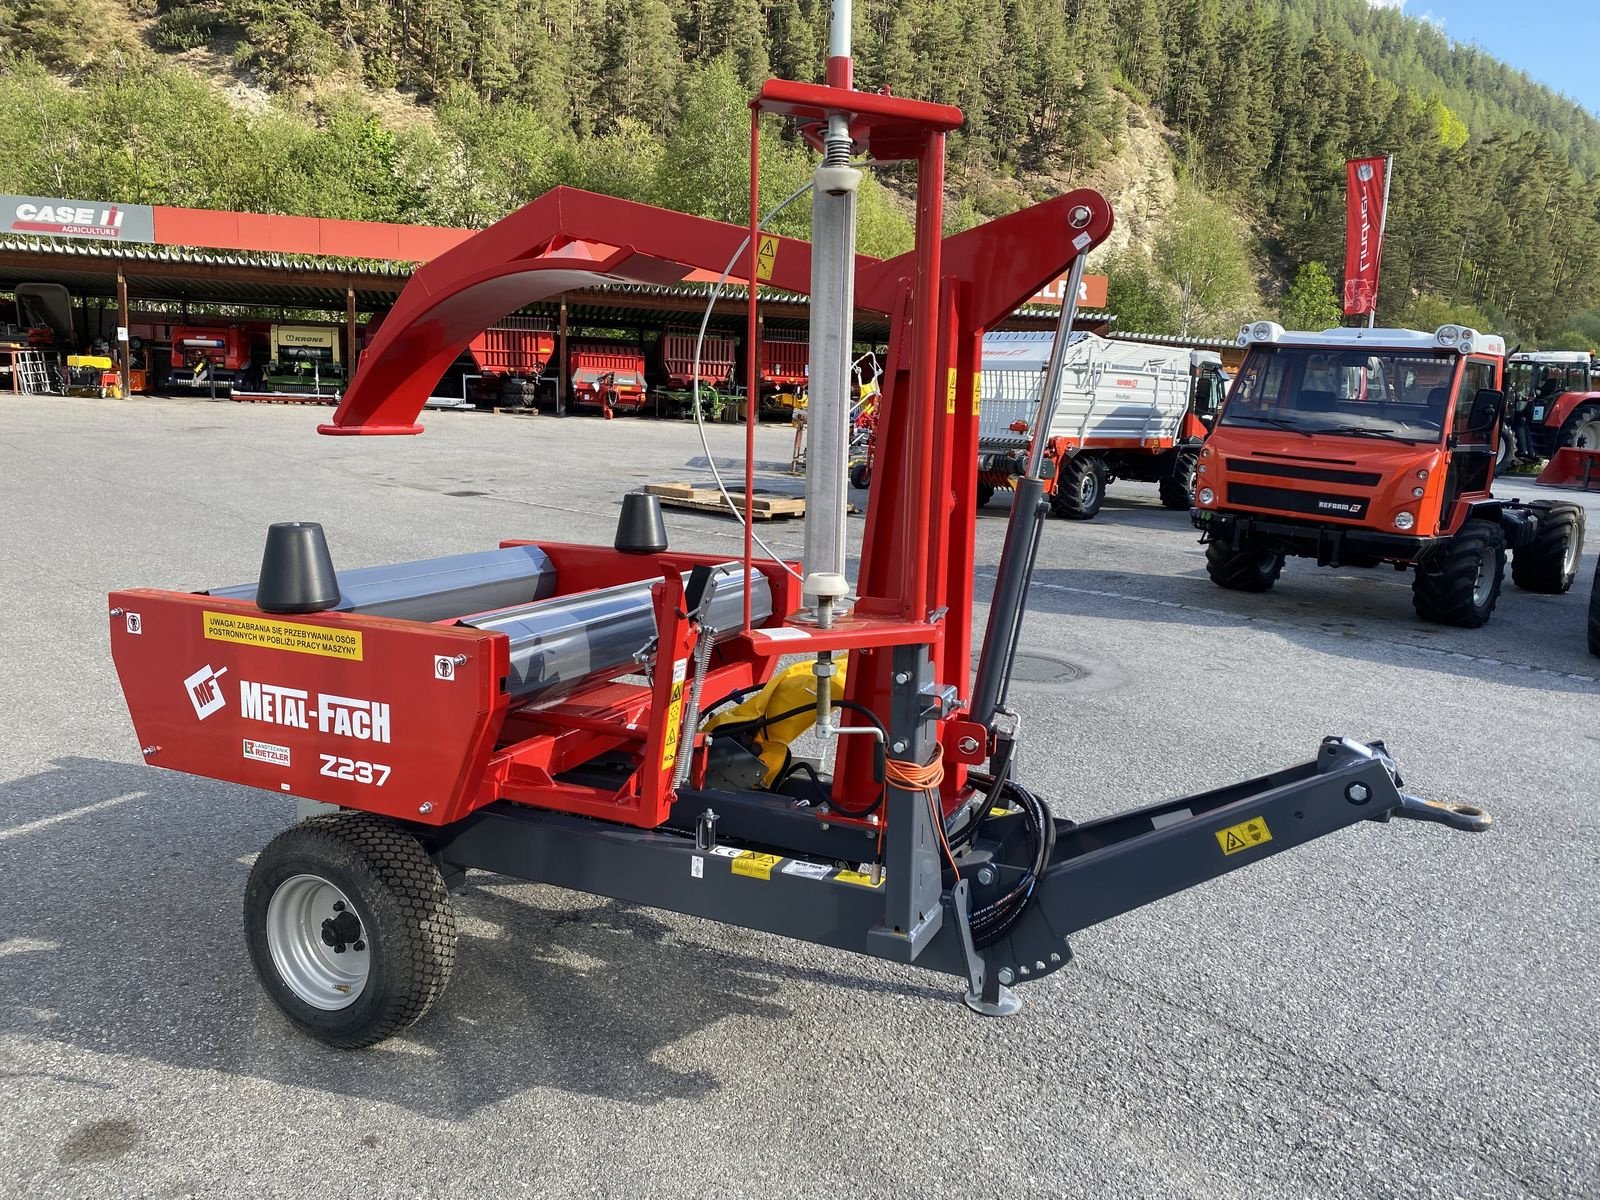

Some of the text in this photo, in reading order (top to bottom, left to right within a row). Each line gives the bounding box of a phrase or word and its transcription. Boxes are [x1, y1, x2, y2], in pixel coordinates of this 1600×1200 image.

[16, 203, 95, 225] CASE
[62, 226, 116, 236] AGRICULTURE
[1319, 501, 1349, 511] REFORM
[208, 627, 356, 655] POSTRONNYCH W POBLIŻU PRACY MASZYNY
[209, 618, 356, 645] UWAGA! ZABRANIA SIĘ PRZEBYWANIA OSÓB
[240, 680, 391, 744] METAL-FACH
[255, 743, 289, 754] LANDTECHNIK
[255, 749, 289, 762] RIETZLER
[319, 753, 392, 787] Z237
